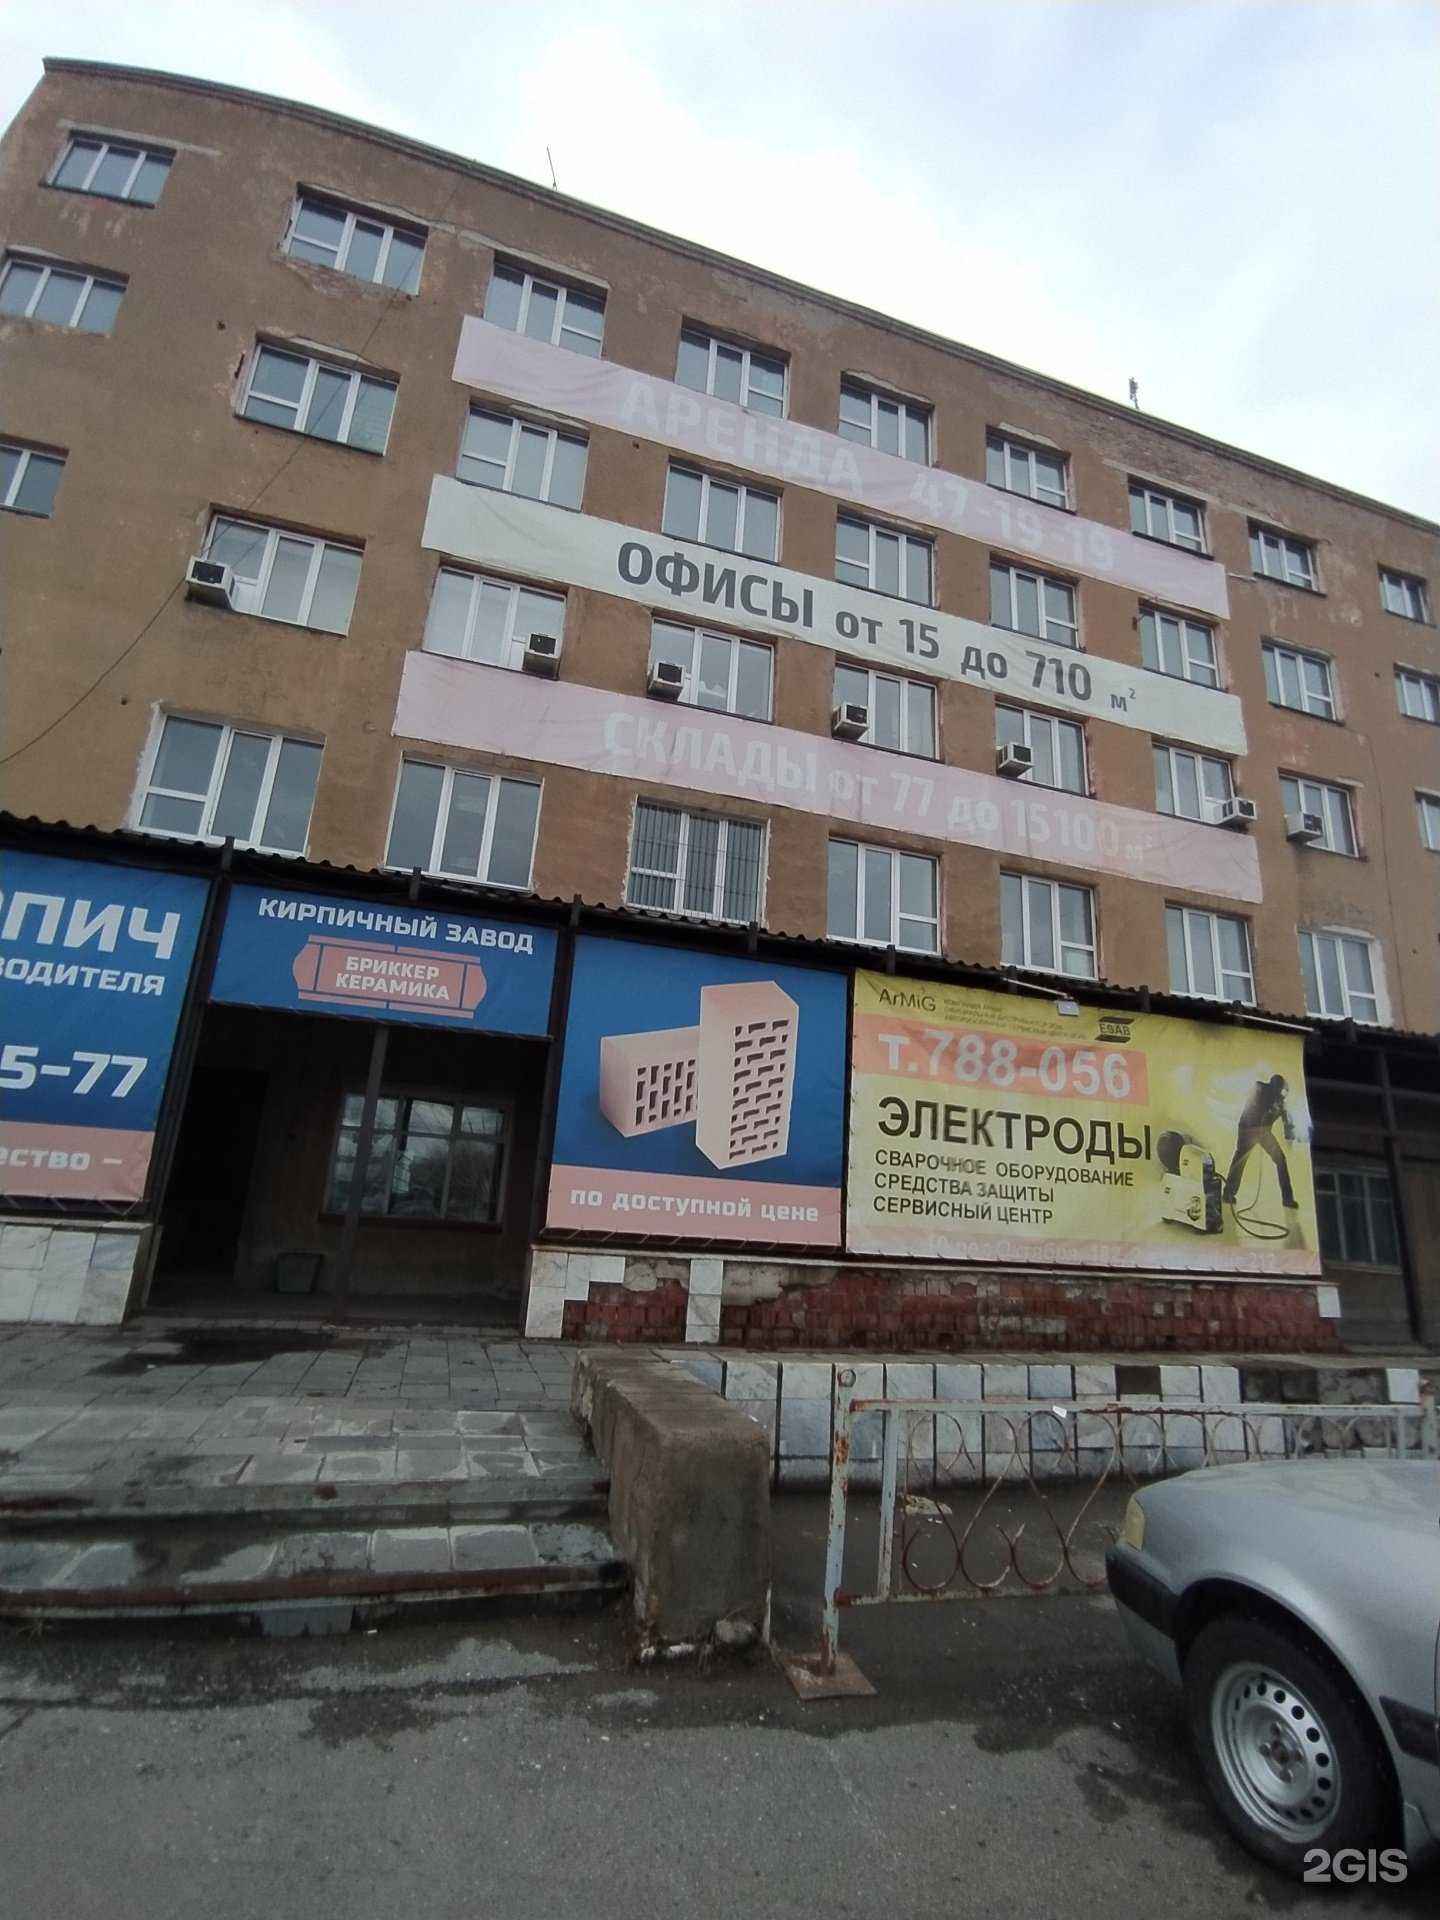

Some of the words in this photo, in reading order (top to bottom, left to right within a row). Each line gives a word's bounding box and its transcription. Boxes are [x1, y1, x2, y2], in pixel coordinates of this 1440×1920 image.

[618, 380, 864, 498] АРЕНДА
[617, 541, 813, 628] ОФИСЫ
[835, 610, 882, 644] от
[900, 619, 940, 659] 15
[960, 645, 1008, 681] до
[1025, 650, 1092, 702] 710
[604, 712, 817, 793] СКЛАДЫ
[829, 769, 878, 805] от
[889, 771, 935, 817] 77
[947, 796, 1000, 835] до
[0, 890, 181, 960] ПИЧ
[258, 898, 437, 939] КИРПИЧНЫЙ
[446, 923, 534, 955] ЗАВОД
[0, 956, 165, 996] ОДИТЕЛЯ
[336, 973, 449, 1001] КЕРАМИКА
[345, 956, 440, 981] БРИККЕР
[878, 1096, 1151, 1165] ЭЛЕКТРОДЫ
[874, 1172, 972, 1197] СРЕДСТВА
[977, 1182, 1054, 1203] ЗАЩИТЫ
[875, 1149, 986, 1175] СВАРОЧНОЕ
[996, 1162, 1134, 1187] ОБОРУДОВАНИЕ
[612, 1194, 751, 1217] доступной
[761, 1203, 818, 1222] цене
[873, 1196, 992, 1221] СЕРВИСНЫЙ
[997, 1207, 1053, 1225] ЦЕНТР
